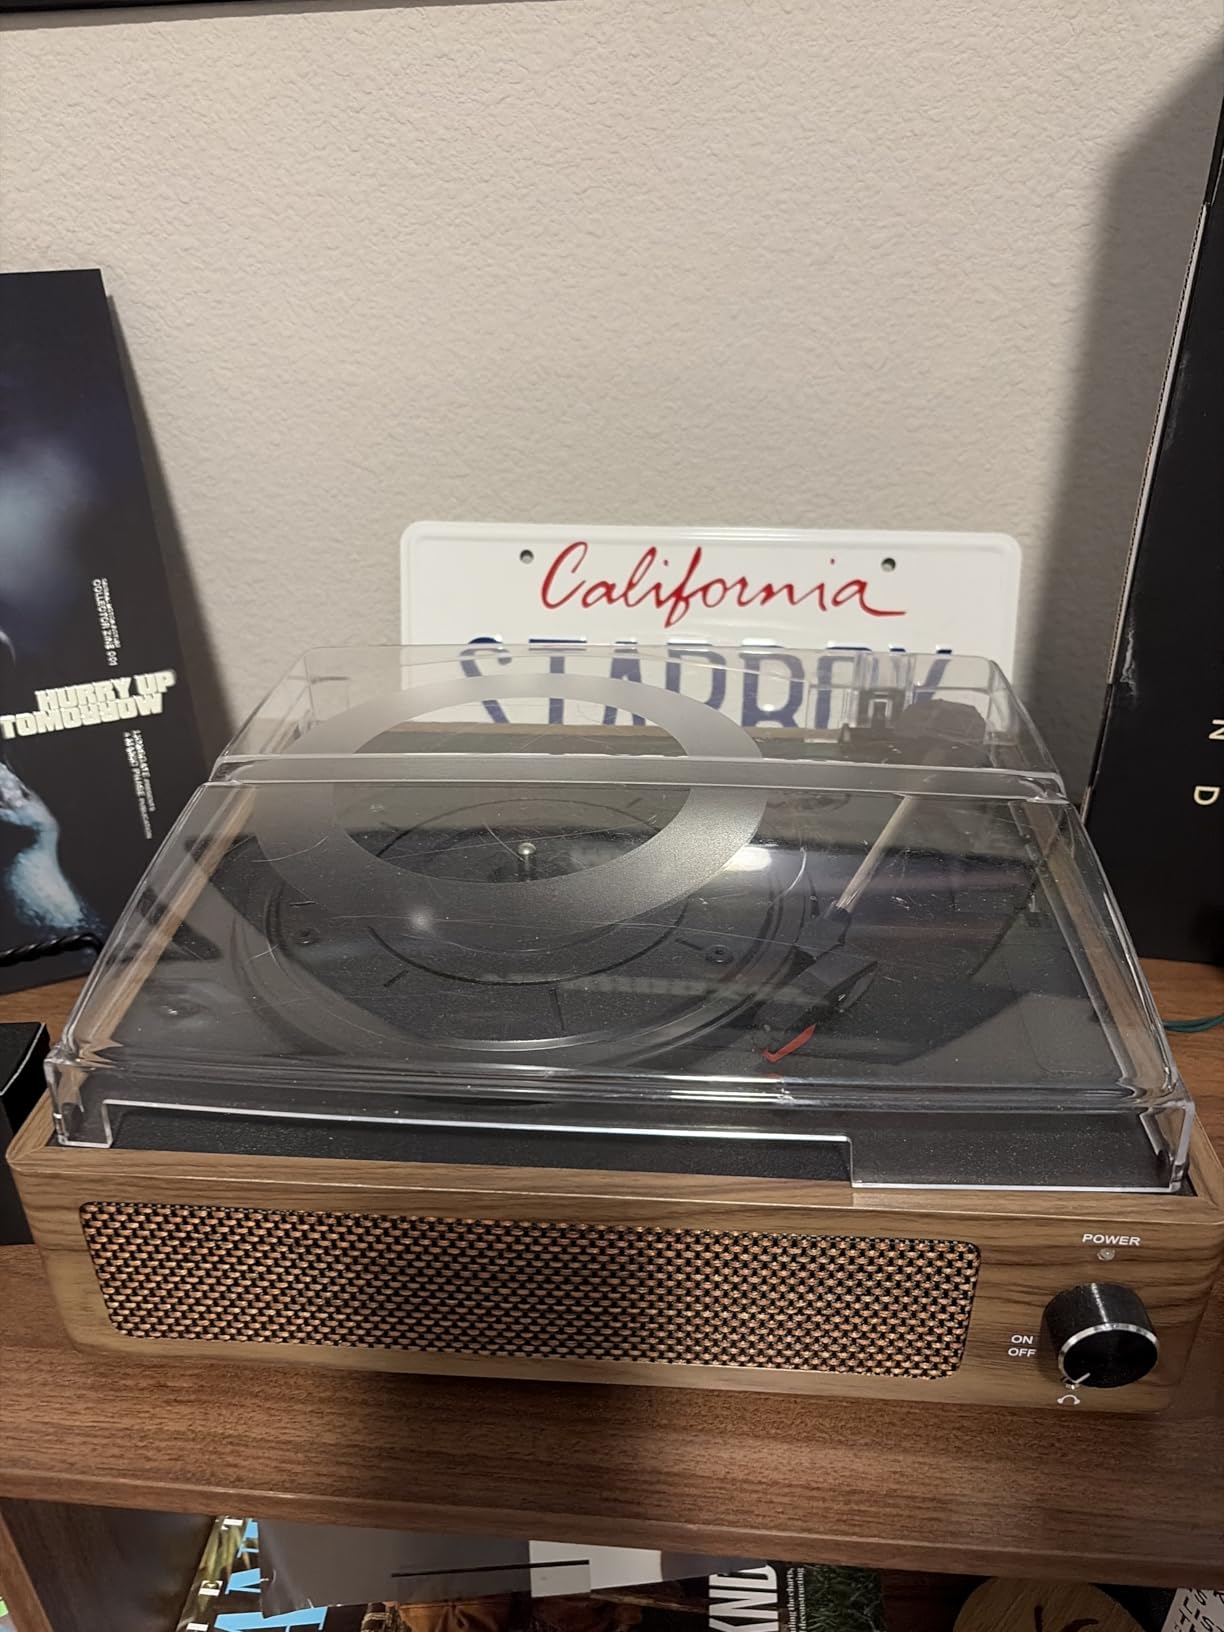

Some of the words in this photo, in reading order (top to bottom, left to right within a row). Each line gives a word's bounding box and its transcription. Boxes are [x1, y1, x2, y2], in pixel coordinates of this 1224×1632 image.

[541, 541, 906, 628] California
[92, 579, 111, 630] COLLECTOR
[34, 677, 131, 711] HURRY
[134, 669, 176, 695] UP
[1082, 1233, 1141, 1247] POWER
[1007, 1347, 1037, 1358] OFF
[1011, 1335, 1034, 1345] ON
